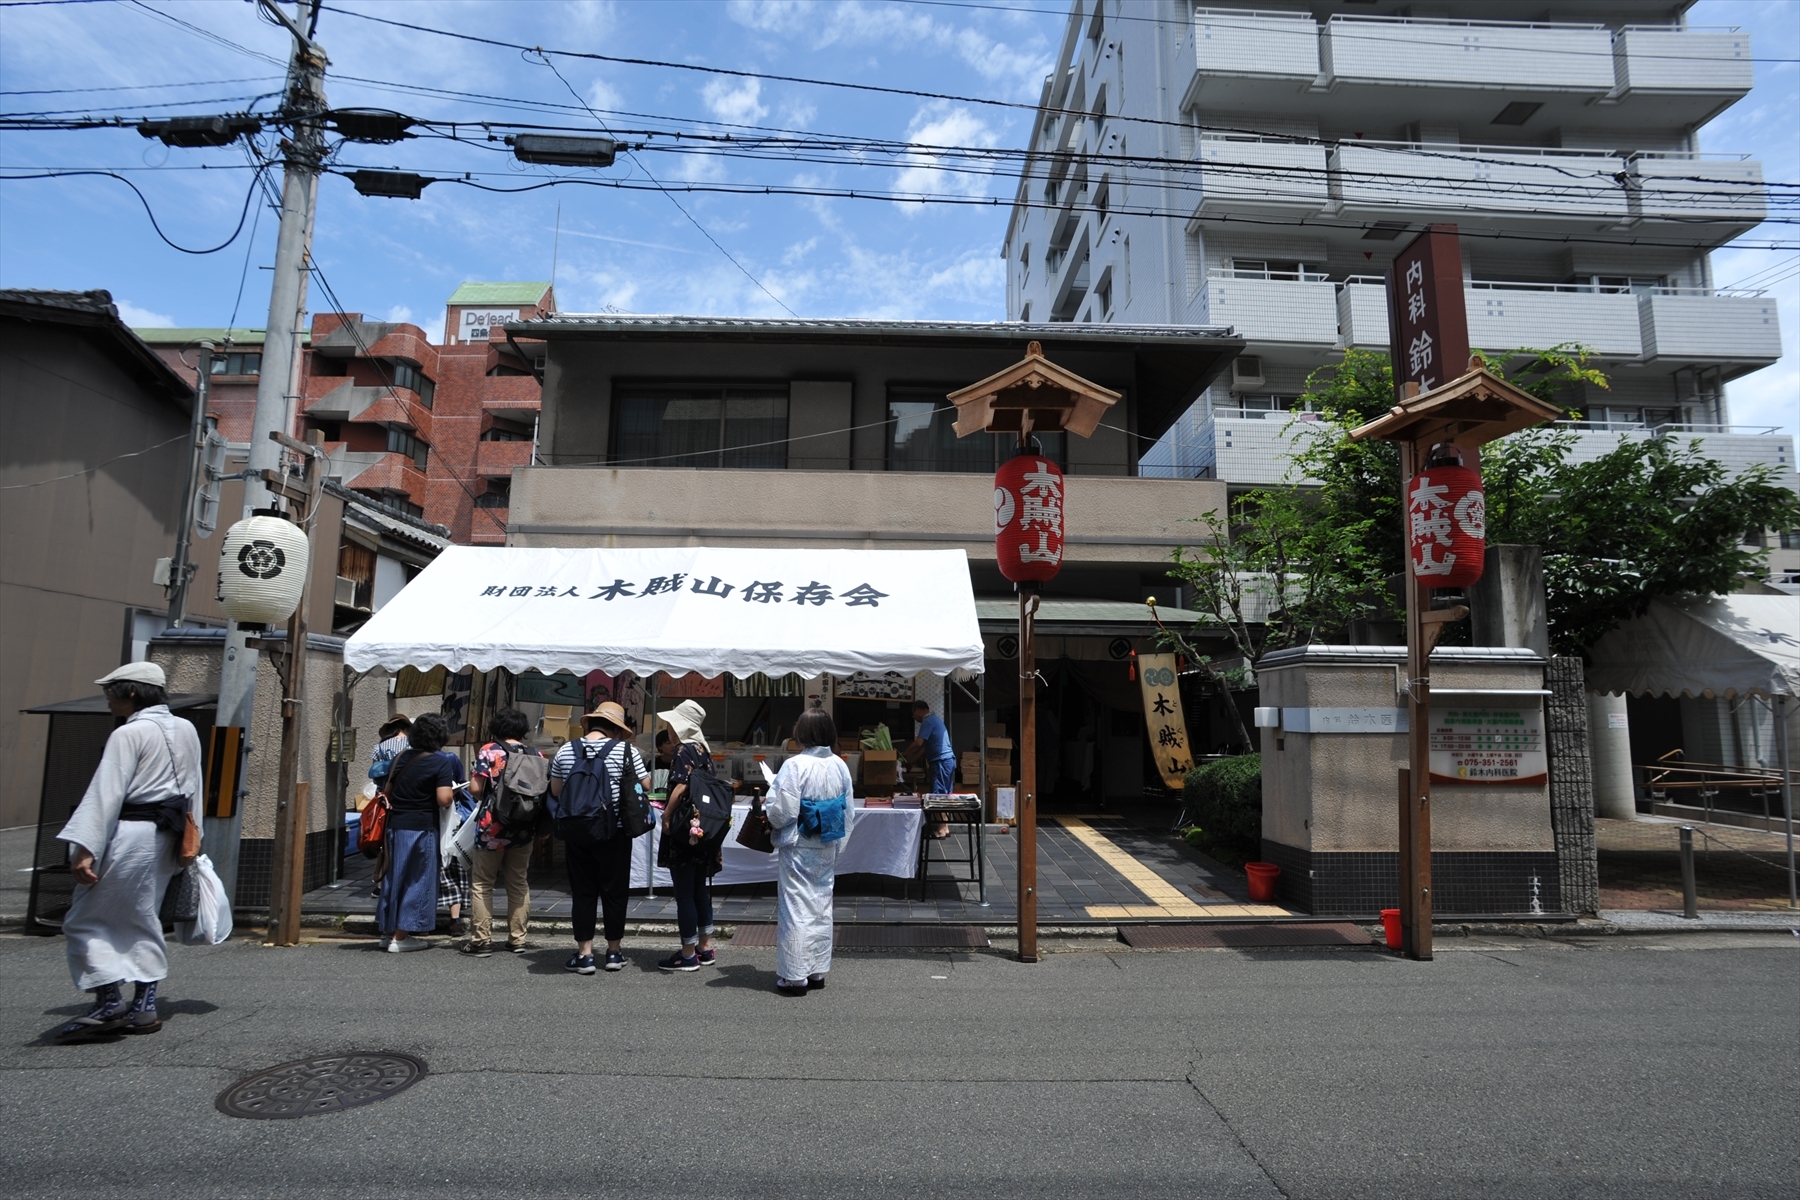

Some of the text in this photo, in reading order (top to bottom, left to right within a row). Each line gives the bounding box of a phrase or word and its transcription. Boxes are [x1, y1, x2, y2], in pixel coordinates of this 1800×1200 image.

[1406, 260, 1426, 325] 内科
[471, 328, 490, 338] 四条
[1019, 461, 1062, 566] 木賊山
[1410, 477, 1456, 576] 木賊山
[480, 573, 890, 607] 財団法人 木賊山保存会
[1152, 693, 1187, 775] 木賊山
[1470, 768, 1518, 777] 鈴木内科医院
